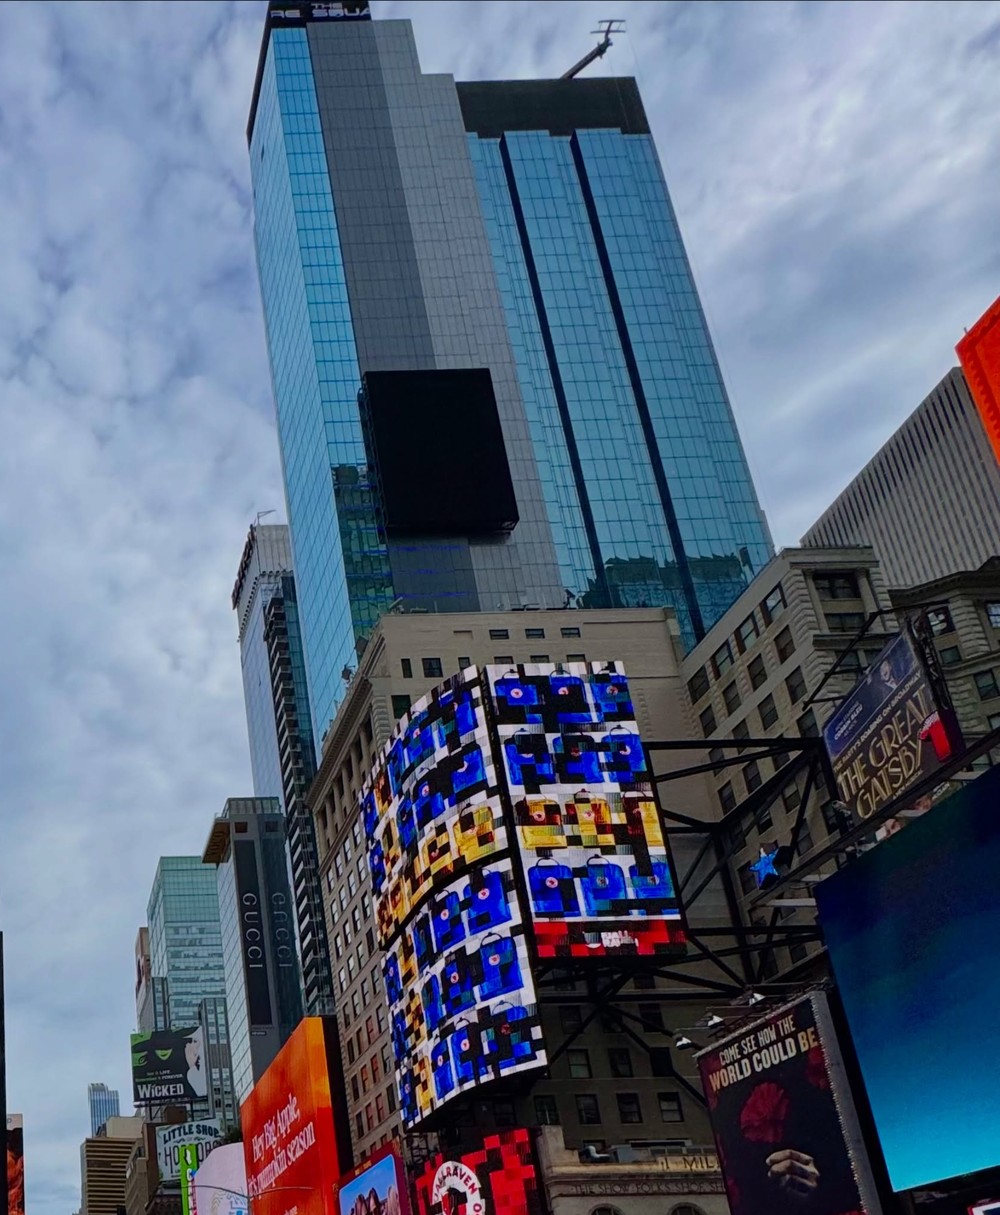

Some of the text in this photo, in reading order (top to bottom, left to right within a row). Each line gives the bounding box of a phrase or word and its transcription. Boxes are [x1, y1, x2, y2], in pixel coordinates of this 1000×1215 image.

[837, 752, 870, 804] THE
[868, 683, 930, 768] GREAT
[856, 728, 923, 819] GATSBY
[242, 893, 263, 968] GUCCI
[708, 1027, 819, 1092] WORLD COULD BE
[719, 1014, 796, 1066] COME SEE HOW THE
[163, 1124, 193, 1144] LITTLE
[195, 1124, 220, 1138] SHOP
[286, 1121, 316, 1166] season
